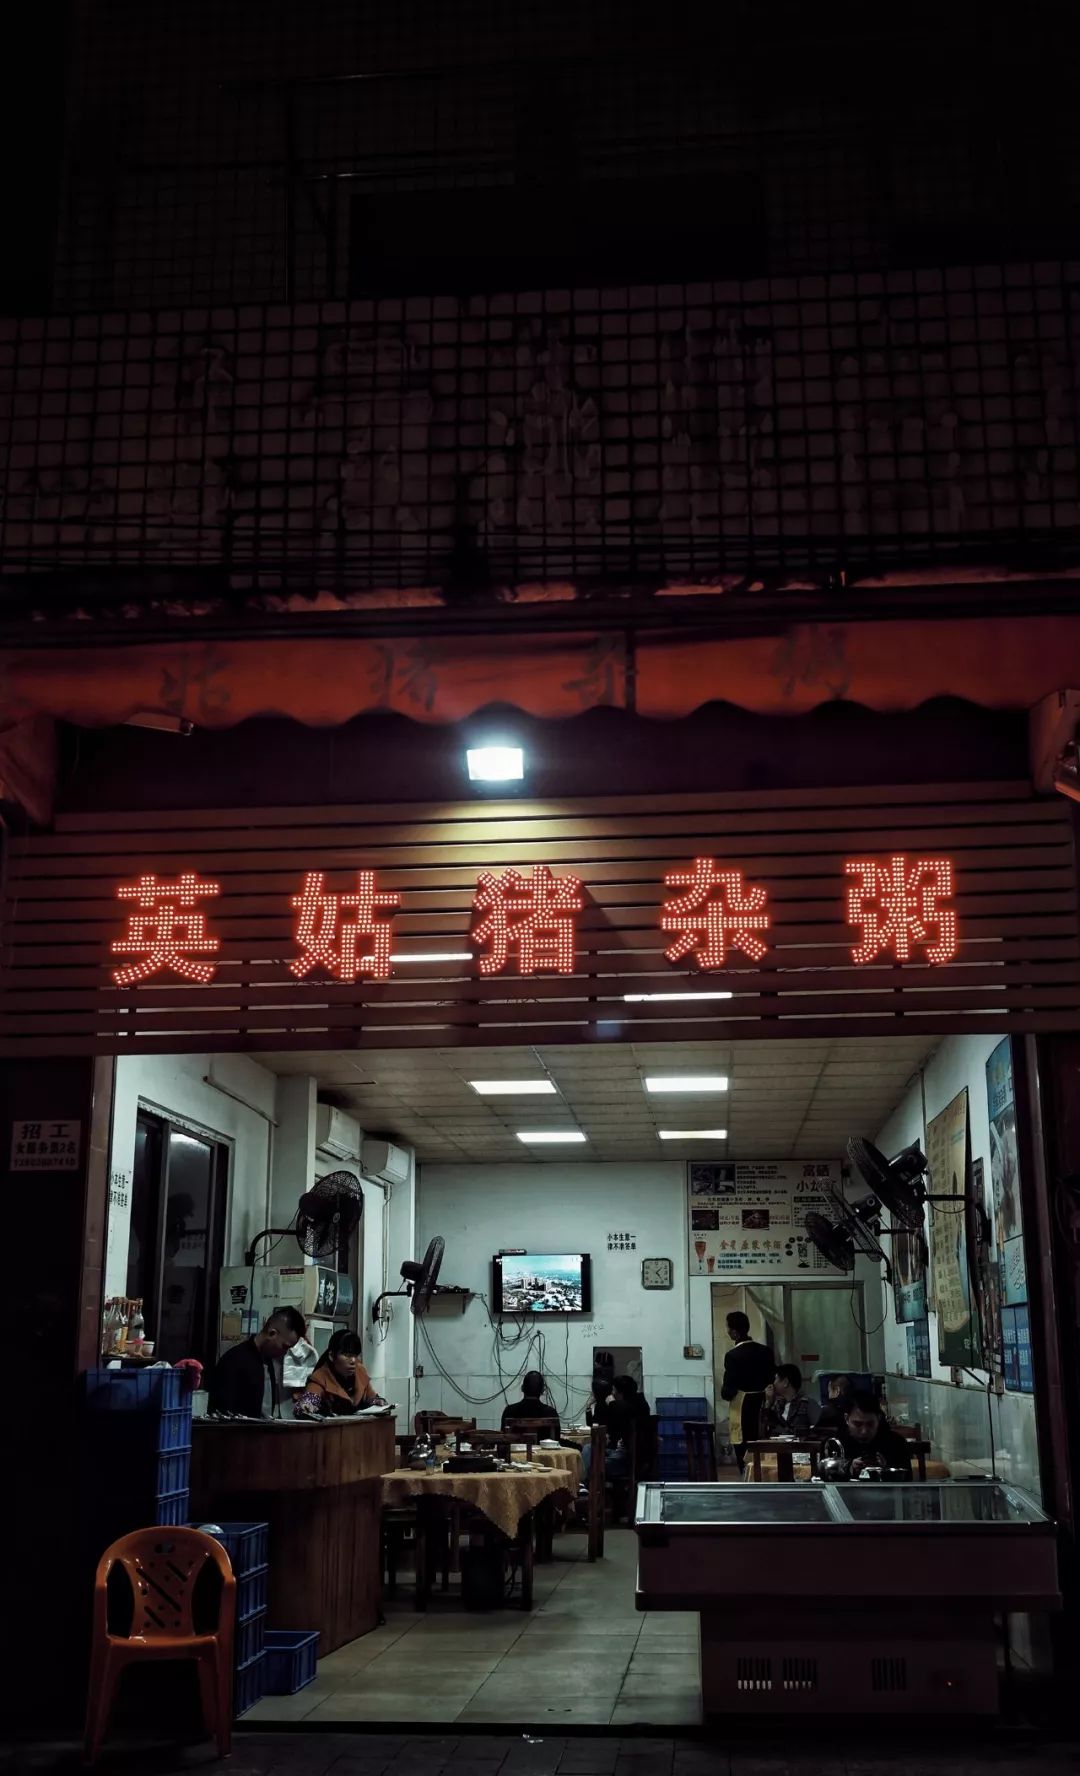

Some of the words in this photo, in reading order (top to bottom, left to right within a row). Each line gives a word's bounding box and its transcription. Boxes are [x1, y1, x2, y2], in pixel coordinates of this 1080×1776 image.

[111, 855, 957, 985] 英姑猪杂粥
[21, 1123, 71, 1140] 招工
